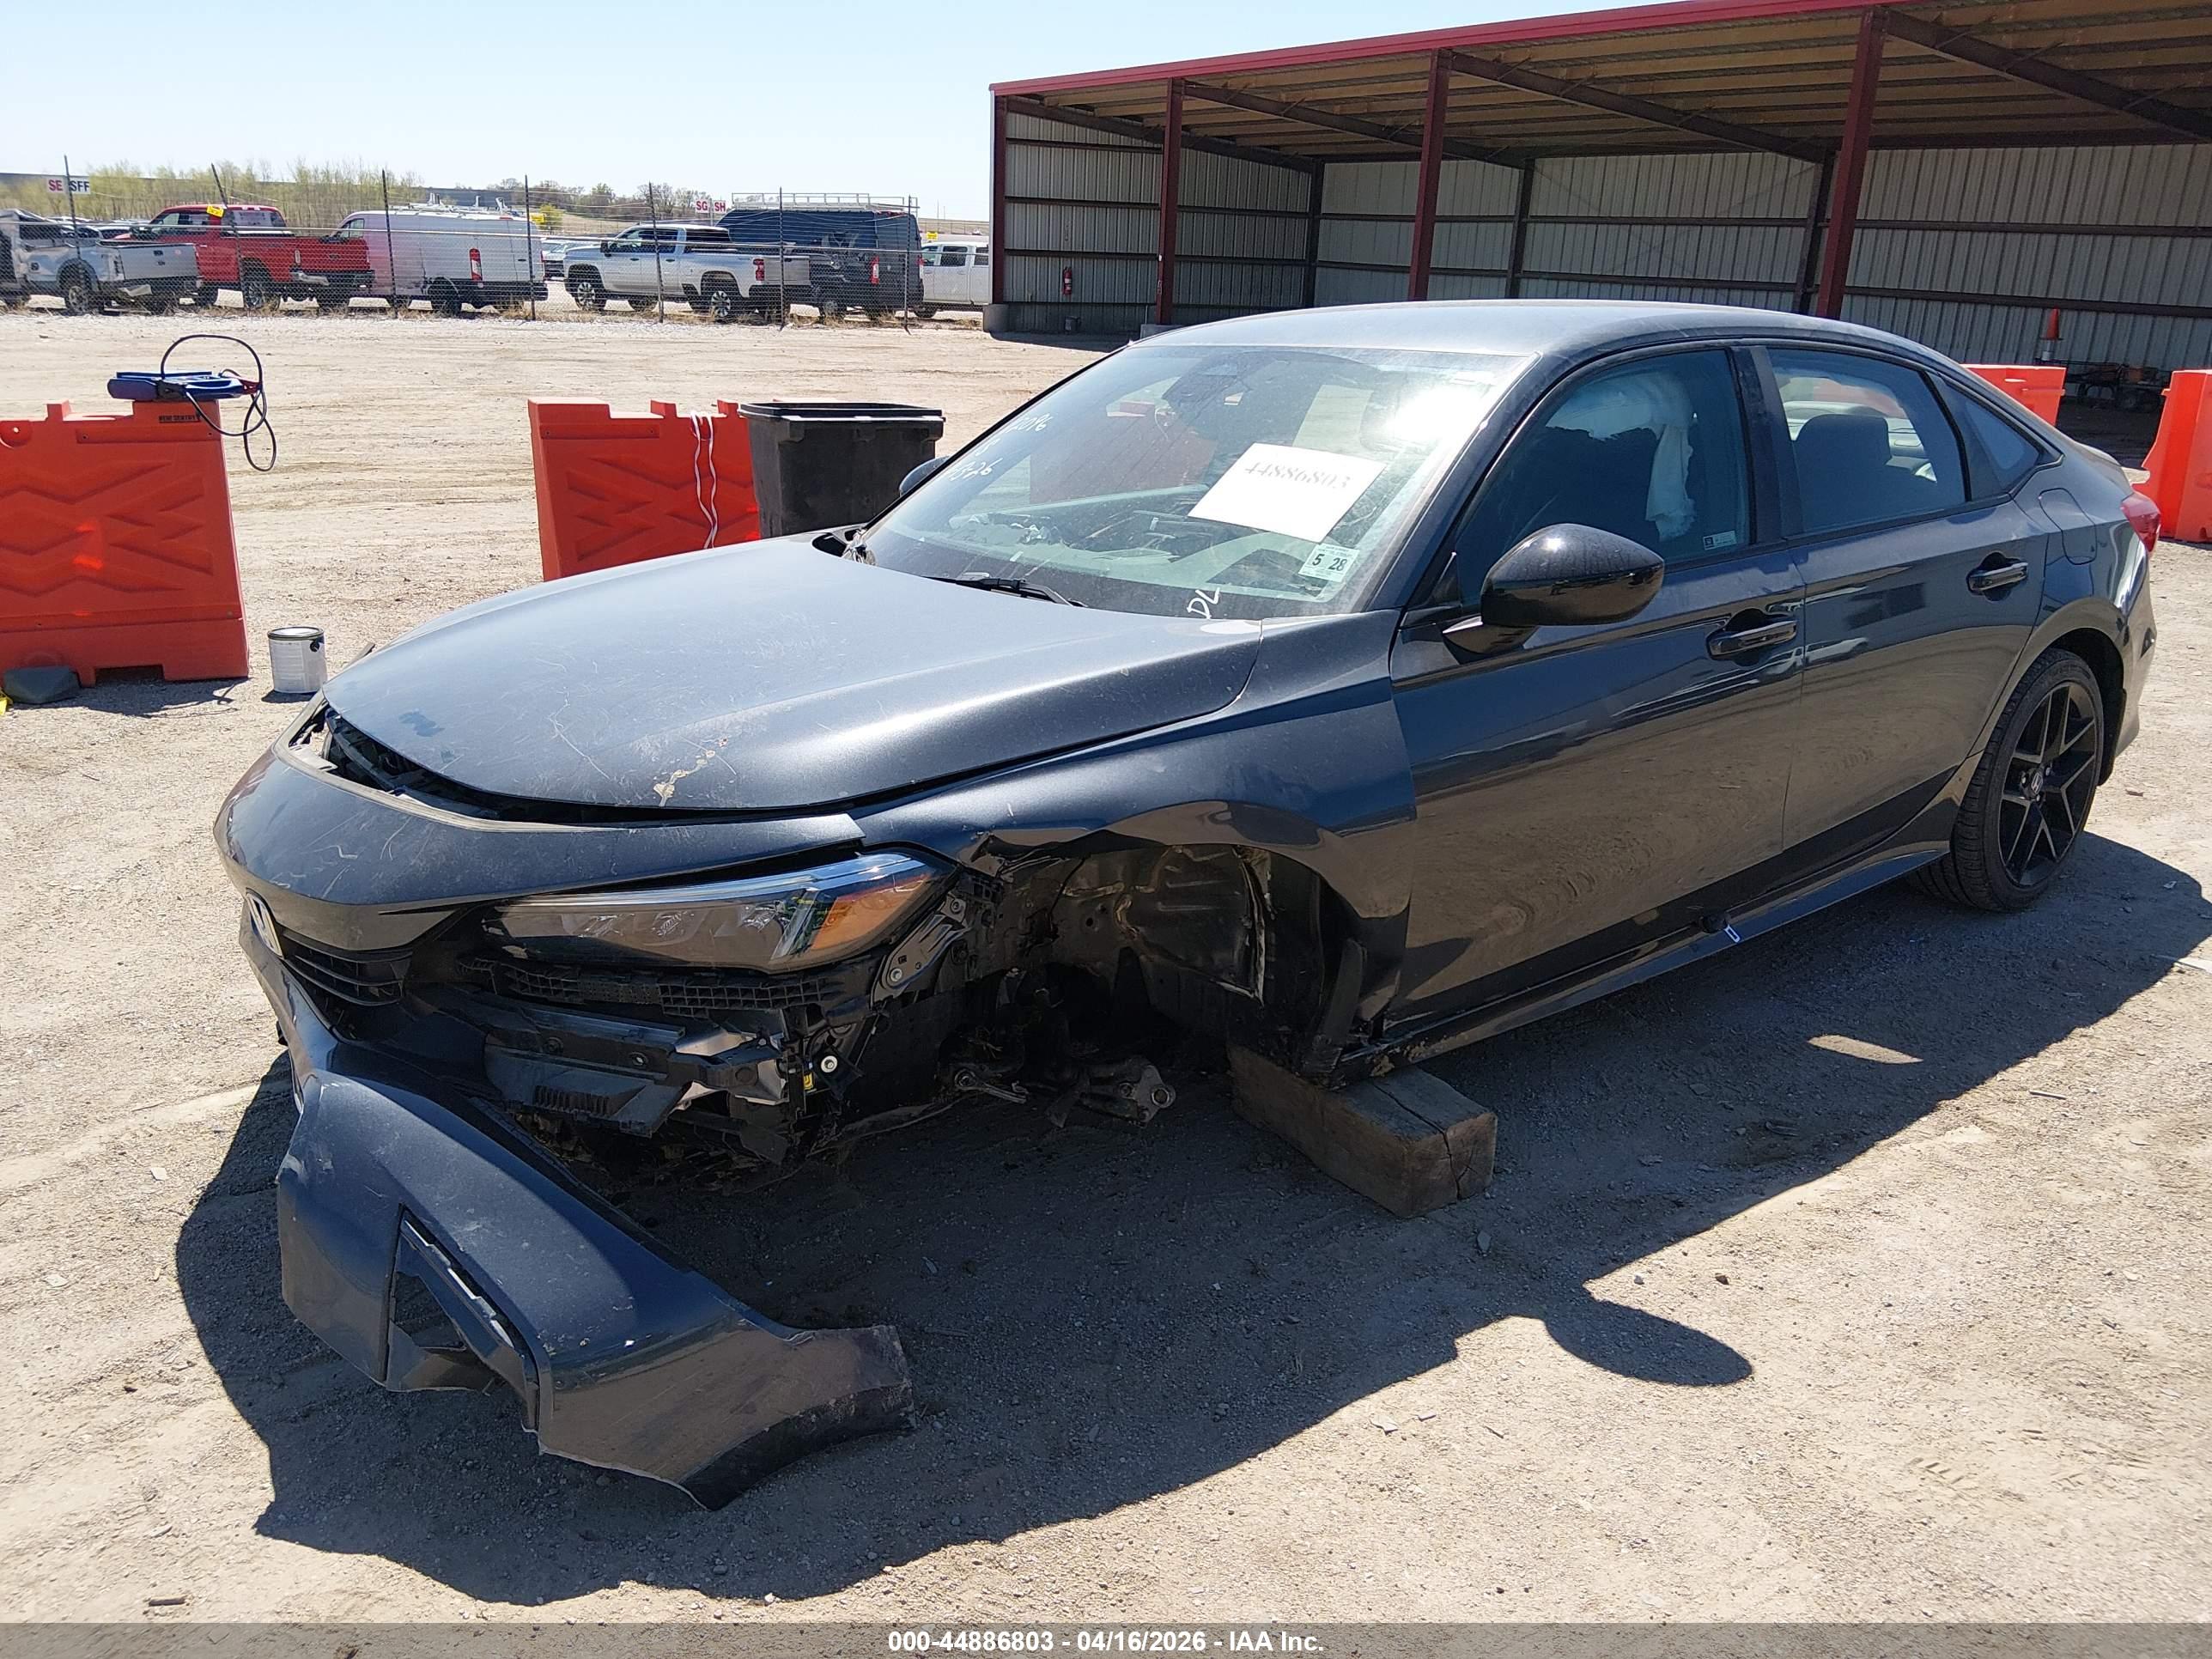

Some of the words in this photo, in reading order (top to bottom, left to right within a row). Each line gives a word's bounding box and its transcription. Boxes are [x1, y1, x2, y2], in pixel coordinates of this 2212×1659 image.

[48, 179, 64, 191] SE
[69, 180, 90, 191] SFF
[696, 200, 708, 211] SG
[714, 202, 726, 212] SH
[1245, 461, 1351, 489] 44886803
[1311, 553, 1325, 566] 5
[1328, 557, 1348, 572] 28
